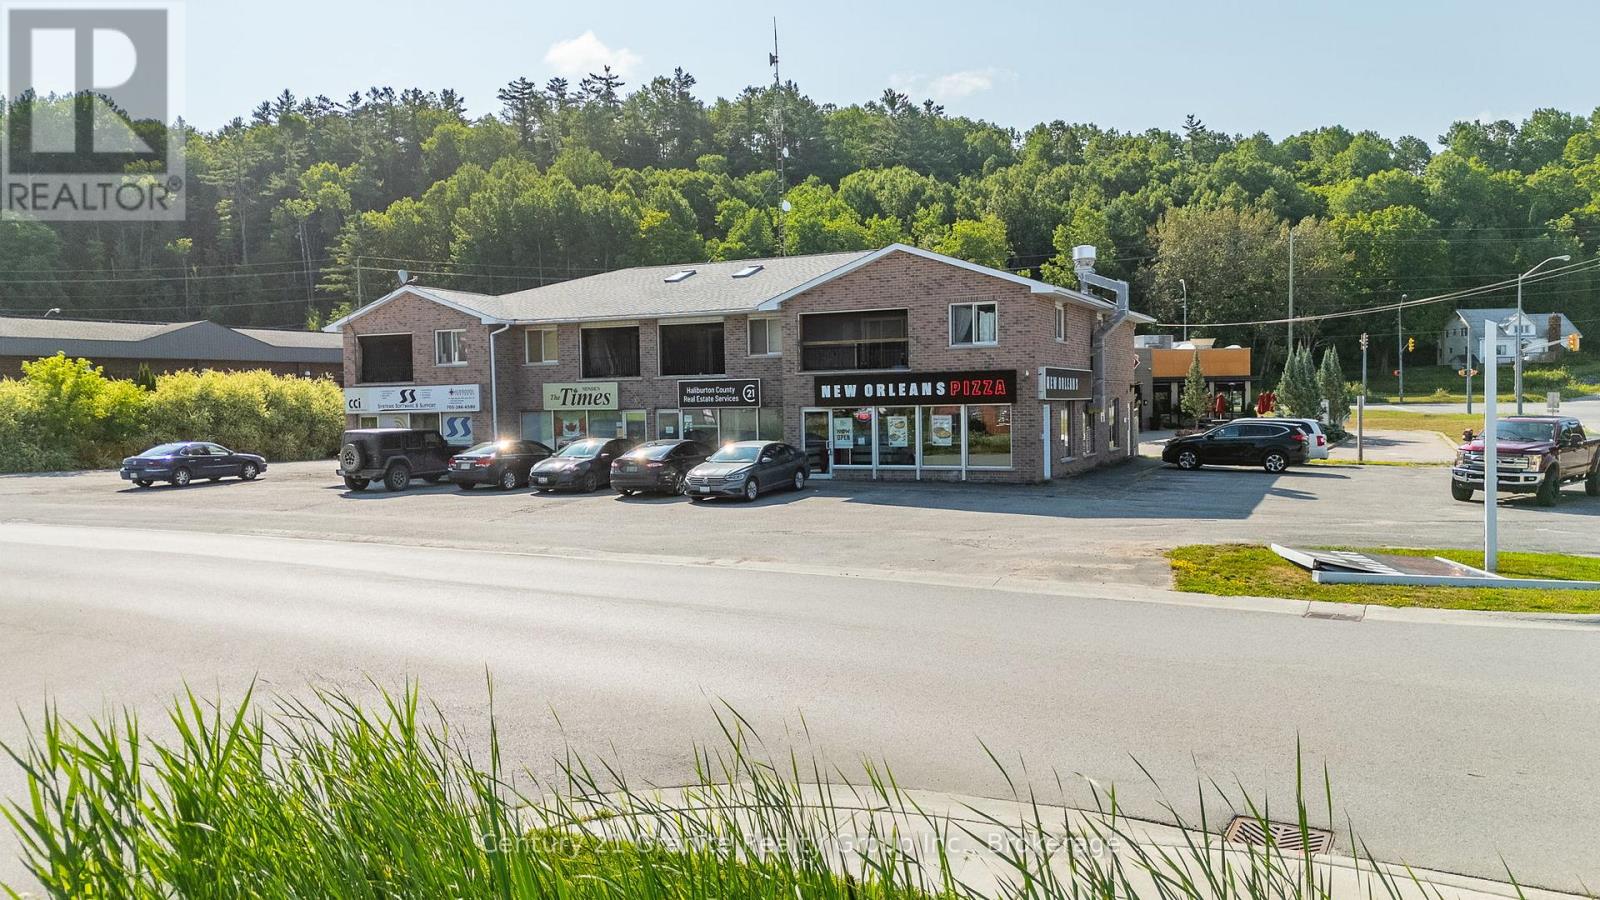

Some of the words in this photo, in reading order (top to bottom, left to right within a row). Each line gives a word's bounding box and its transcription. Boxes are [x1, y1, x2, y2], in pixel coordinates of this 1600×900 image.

[715, 386, 735, 395] County
[821, 384, 857, 398] NEW
[864, 382, 946, 397] ORLEANS
[950, 379, 1006, 396] PIZZA
[1046, 376, 1057, 389] NEW
[560, 387, 611, 406] Times
